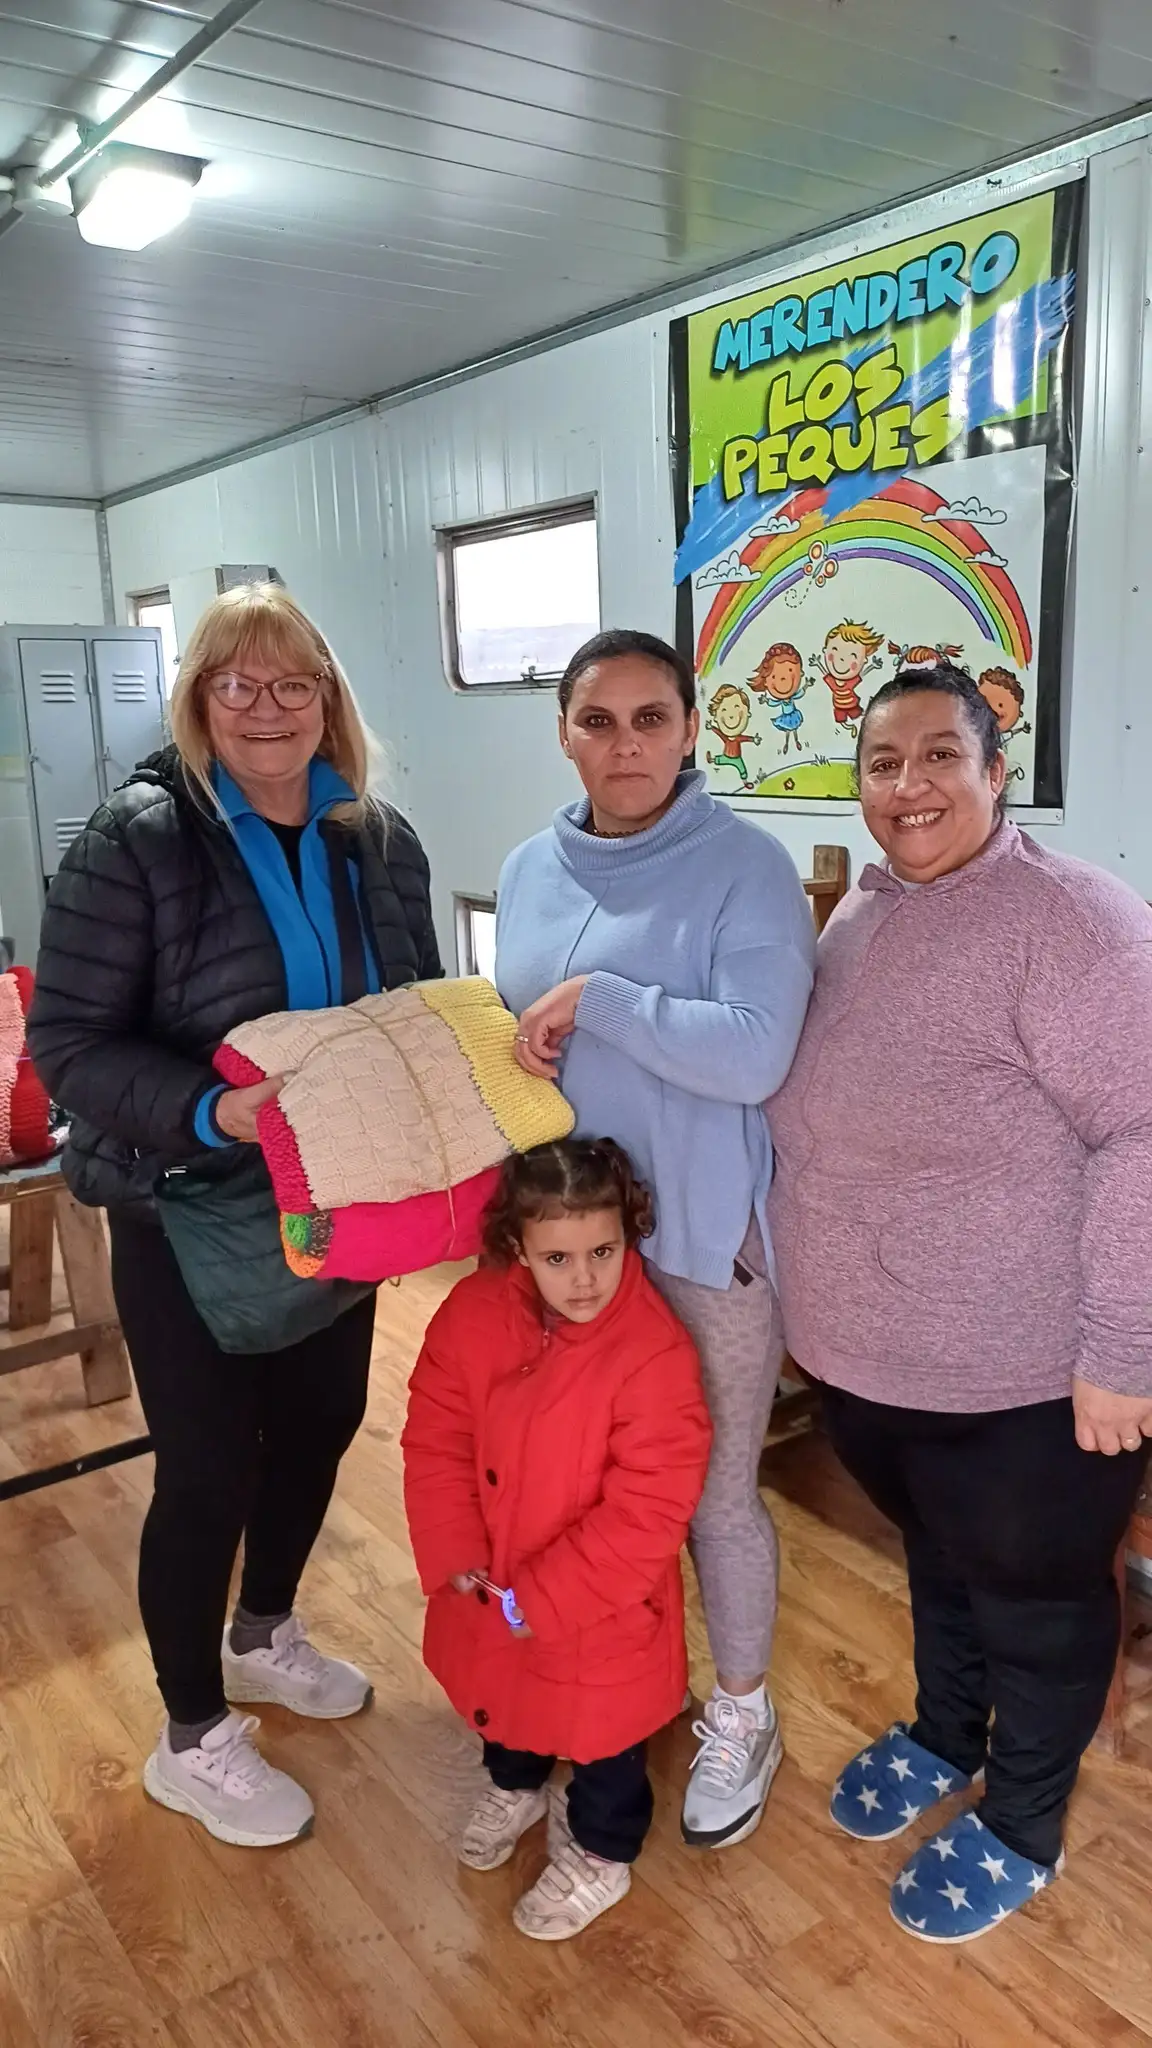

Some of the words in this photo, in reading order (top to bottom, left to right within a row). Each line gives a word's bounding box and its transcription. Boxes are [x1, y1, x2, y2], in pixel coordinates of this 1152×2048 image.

[713, 231, 1020, 373] MERENDERO
[768, 343, 904, 437] LOS
[722, 394, 964, 500] PEQUES
